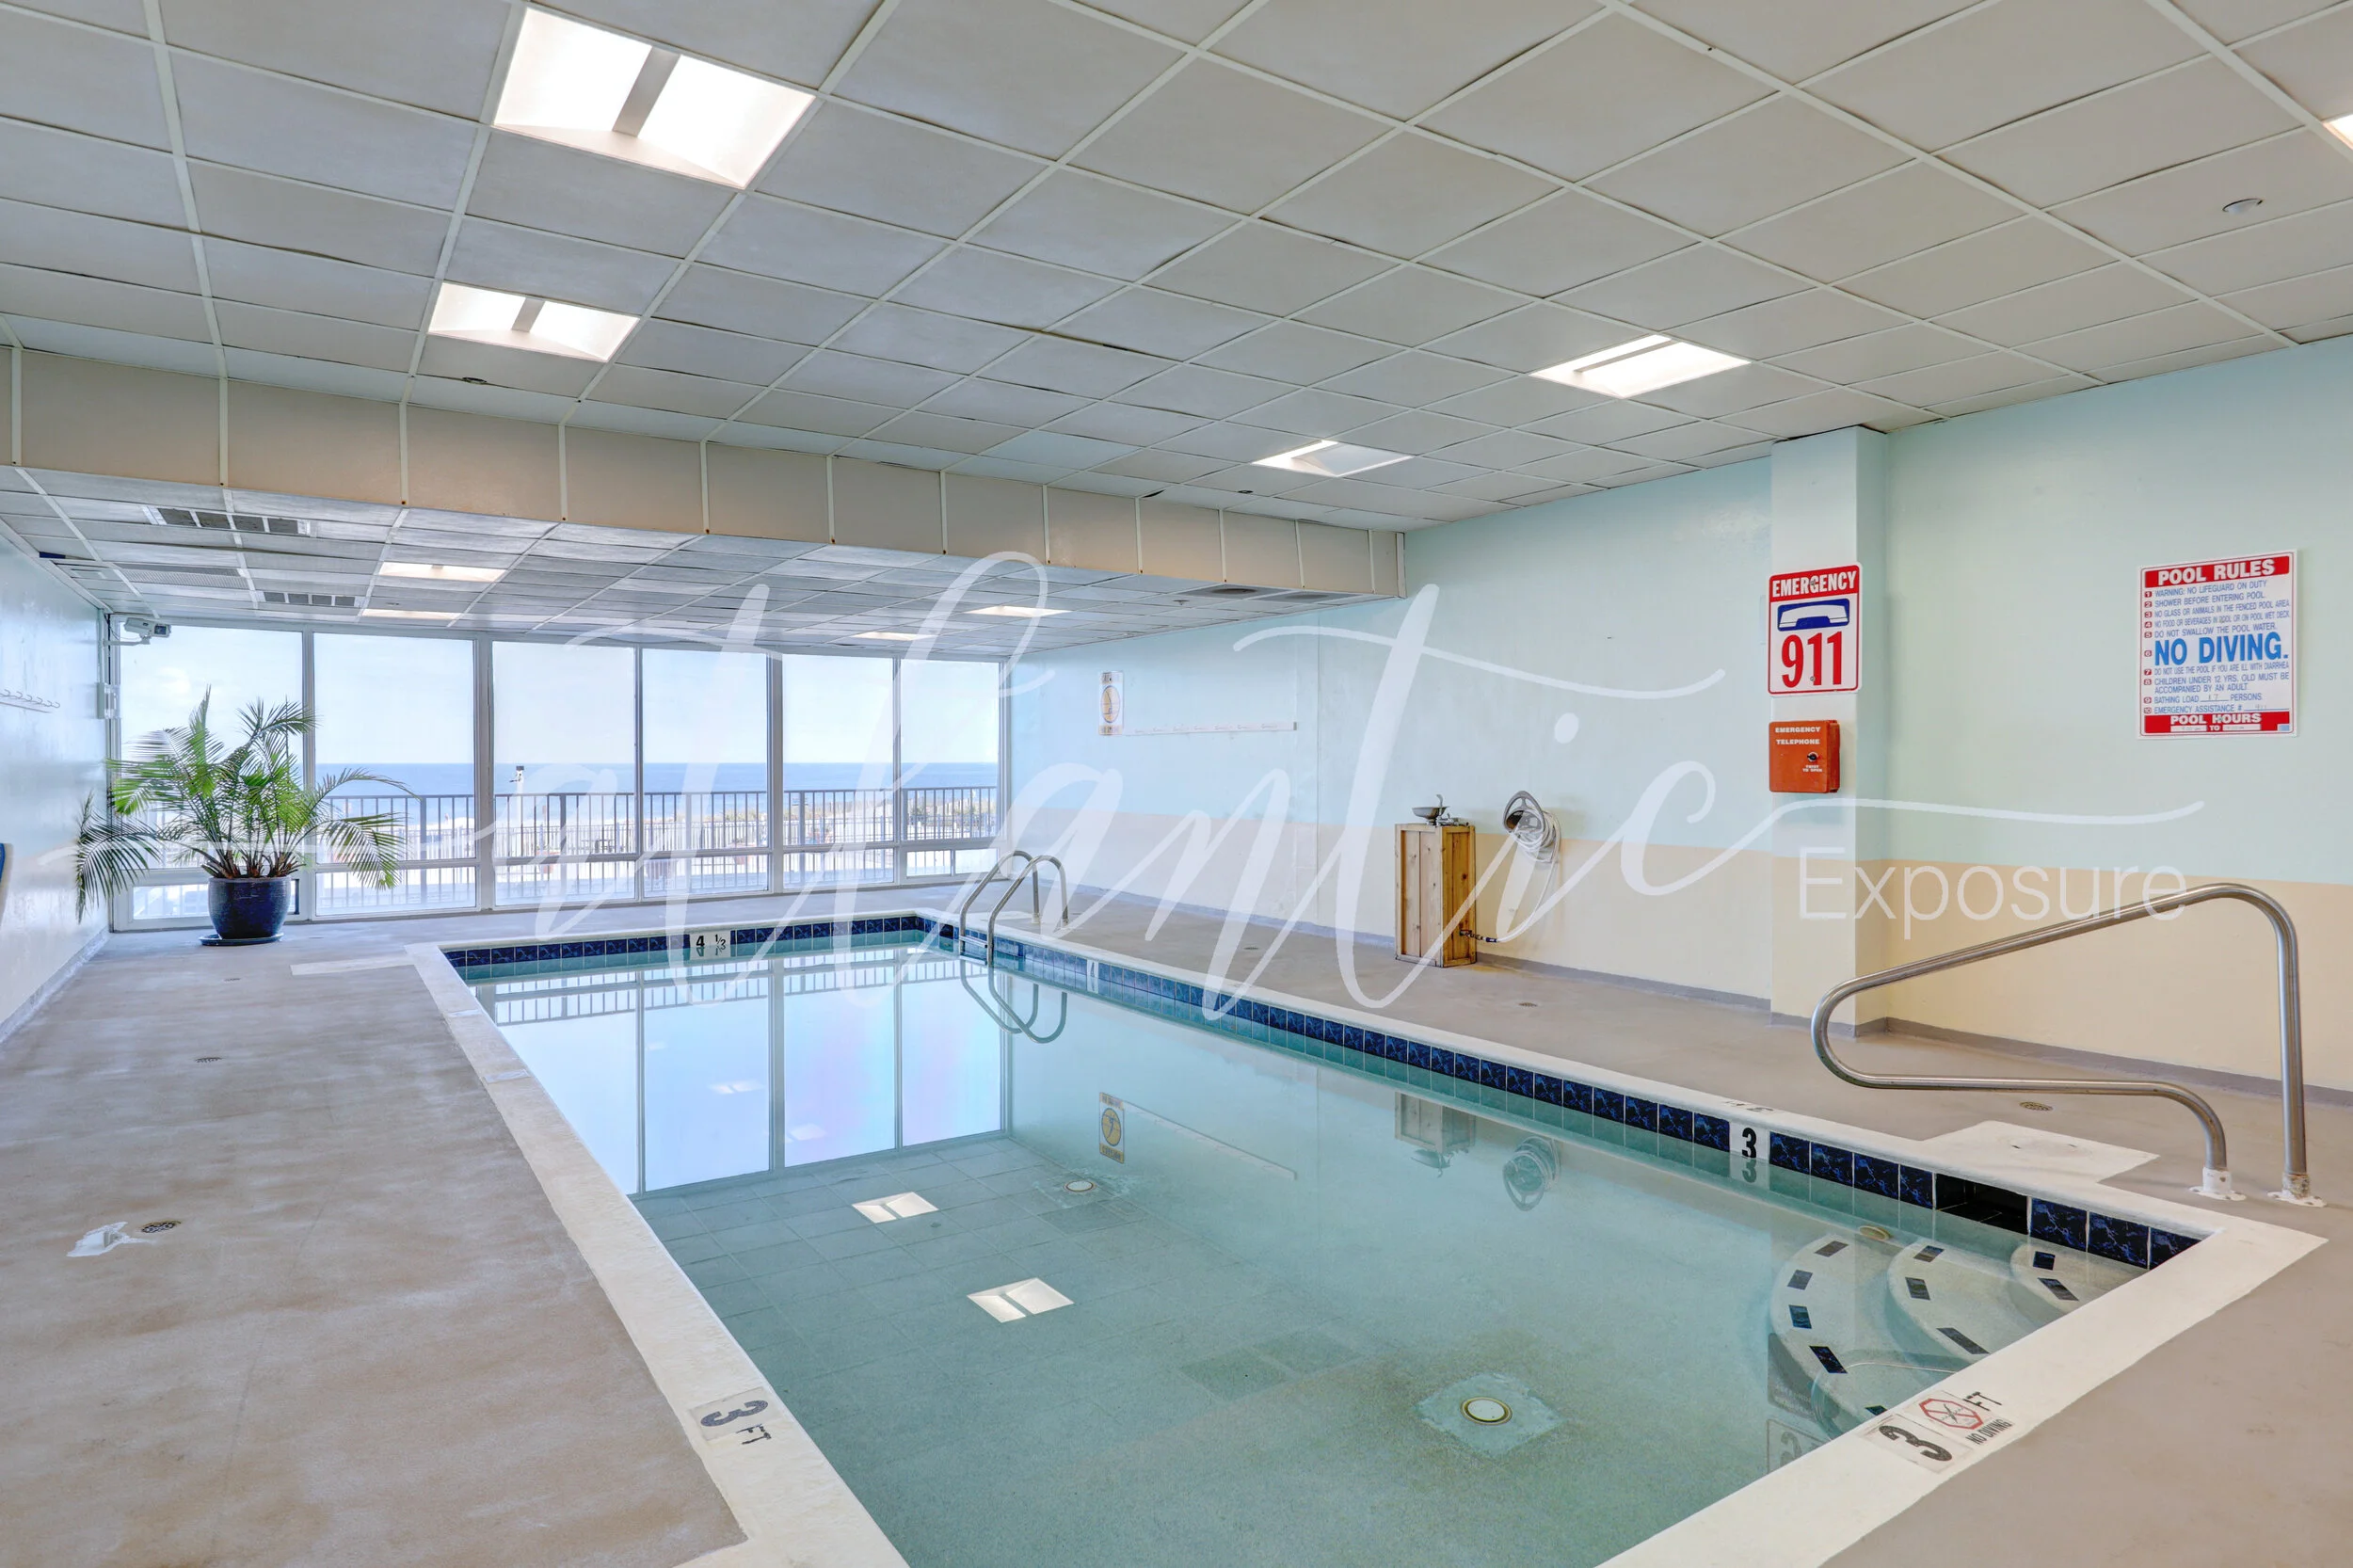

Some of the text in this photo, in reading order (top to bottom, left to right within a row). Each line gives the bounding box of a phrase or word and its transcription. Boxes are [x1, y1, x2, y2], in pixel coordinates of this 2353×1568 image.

[2159, 560, 2275, 585] POOL RULES
[1773, 571, 1856, 597] EMERGENCY
[2155, 589, 2184, 597] WARNING:
[2199, 583, 2234, 593] LIFEGUARD
[2250, 580, 2267, 588] DUTY
[2155, 599, 2181, 607] SHOWER
[2184, 596, 2209, 605] BEFORE
[2212, 593, 2243, 602] ENTERING
[2164, 609, 2180, 617] GLASS
[2192, 606, 2214, 614] ANIMALS
[2236, 601, 2256, 610] FENCED
[2163, 619, 2175, 627] FOOD
[2185, 617, 2211, 626] BEVERAGES
[2219, 615, 2232, 623] POOL
[2251, 613, 2263, 621] POOL
[2155, 630, 2164, 638] DO
[2167, 629, 2179, 637] NOT
[2182, 626, 2214, 636] SWALLOW
[2217, 625, 2229, 634] THE
[2232, 624, 2250, 633] POOL
[2155, 638, 2187, 665] NO
[2199, 632, 2289, 663] DIVING.
[1782, 631, 1841, 688] 911
[2155, 677, 2187, 685] CHILDREN
[2189, 675, 2211, 684] UNDER
[2155, 685, 2201, 694] ACCOMPANIED
[2204, 683, 2213, 692] BY
[2154, 705, 2192, 714] EMERGENCY
[2195, 704, 2235, 713] ASSISTANCE
[2171, 713, 2262, 725] POOL HOURS
[696, 935, 705, 946] 4
[1742, 1127, 1756, 1158] 3
[1963, 1391, 2003, 1411] FT
[701, 1400, 768, 1426] 3
[736, 1423, 771, 1445] FT
[1966, 1419, 2013, 1444] NO DIVING
[1879, 1425, 1952, 1461] 3
